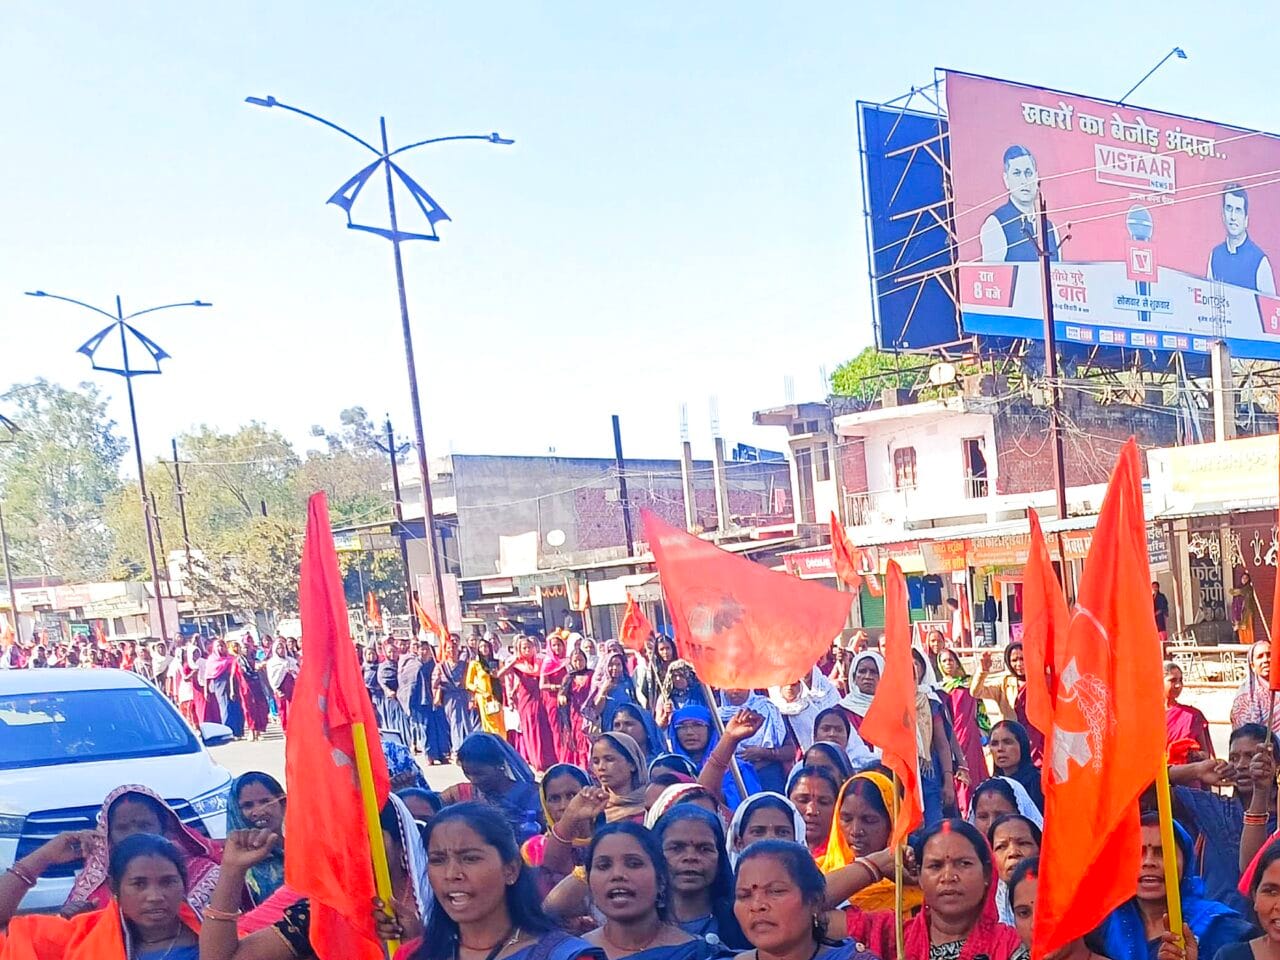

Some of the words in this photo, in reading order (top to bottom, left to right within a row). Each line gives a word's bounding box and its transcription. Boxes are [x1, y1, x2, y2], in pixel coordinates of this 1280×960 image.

[1021, 102, 1074, 131] खबरों
[1078, 112, 1105, 137] का
[1110, 113, 1160, 149] बेजोड़
[1099, 149, 1172, 178] VISTAAR
[1150, 180, 1168, 190] NEWS
[979, 271, 994, 282] रात
[974, 282, 983, 299] 8
[985, 287, 1001, 300] बजे
[1057, 284, 1087, 303] बात
[1117, 295, 1140, 308] सोमवार
[1142, 296, 1149, 308] से
[1270, 316, 1278, 330] 9
